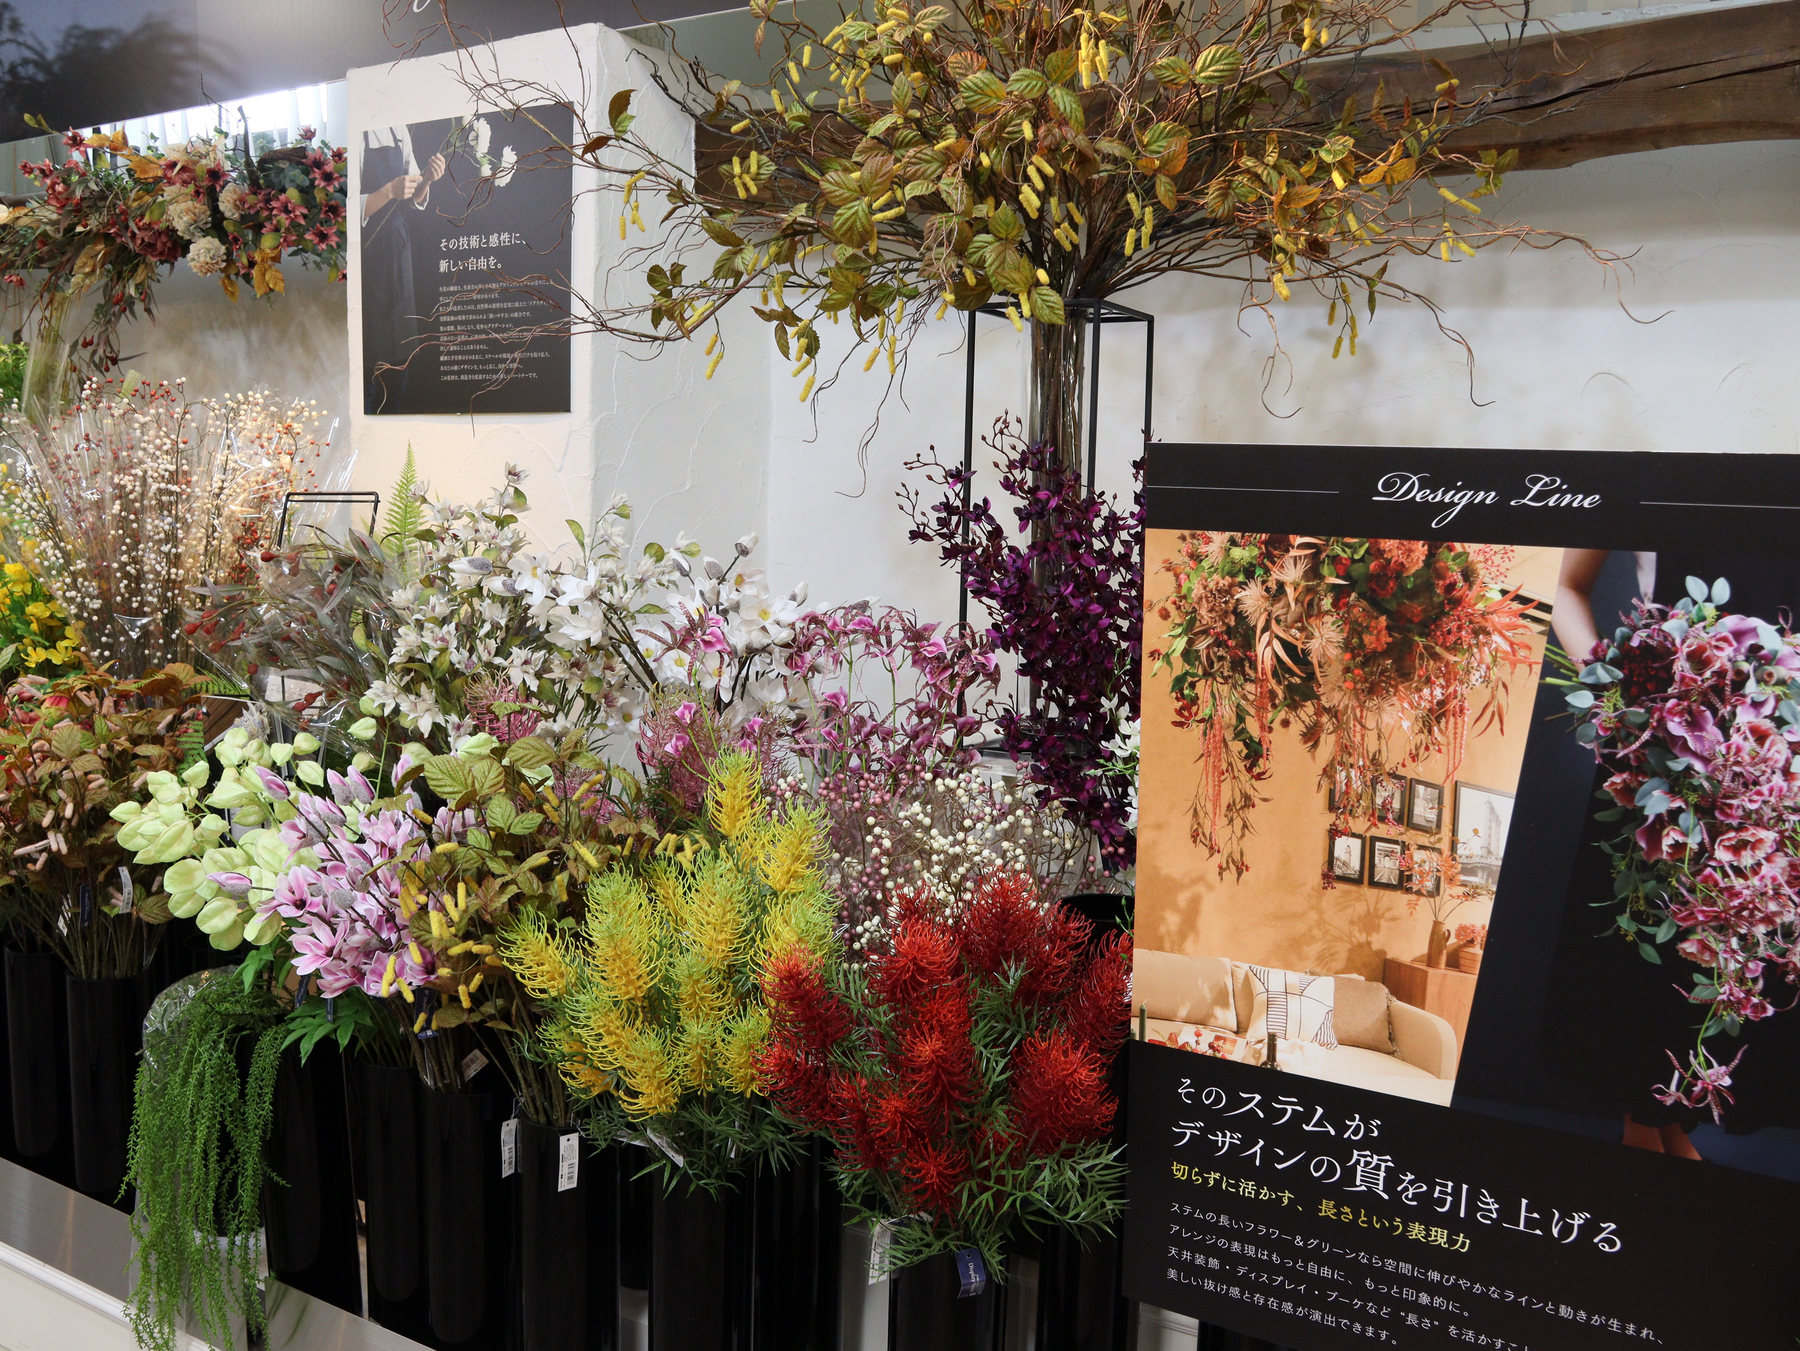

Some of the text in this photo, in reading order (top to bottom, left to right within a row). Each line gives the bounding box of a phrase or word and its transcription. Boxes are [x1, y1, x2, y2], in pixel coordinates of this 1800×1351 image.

[439, 231, 526, 251] その技術と感性に、
[439, 255, 502, 273] 新しい自由を。
[1371, 471, 1602, 529] Design Line
[1177, 1077, 1382, 1141] そのステムが
[1170, 1161, 1471, 1253] 切らずに活かす、長さという表現力
[1171, 1121, 1623, 1253] デザインの質を引き上げる
[1167, 1267, 1398, 1346] 美しい抜け感と存在感が演出できます。
[1169, 1224, 1469, 1318] アレンジの表現はもっと自由に、もっと印象的に。
